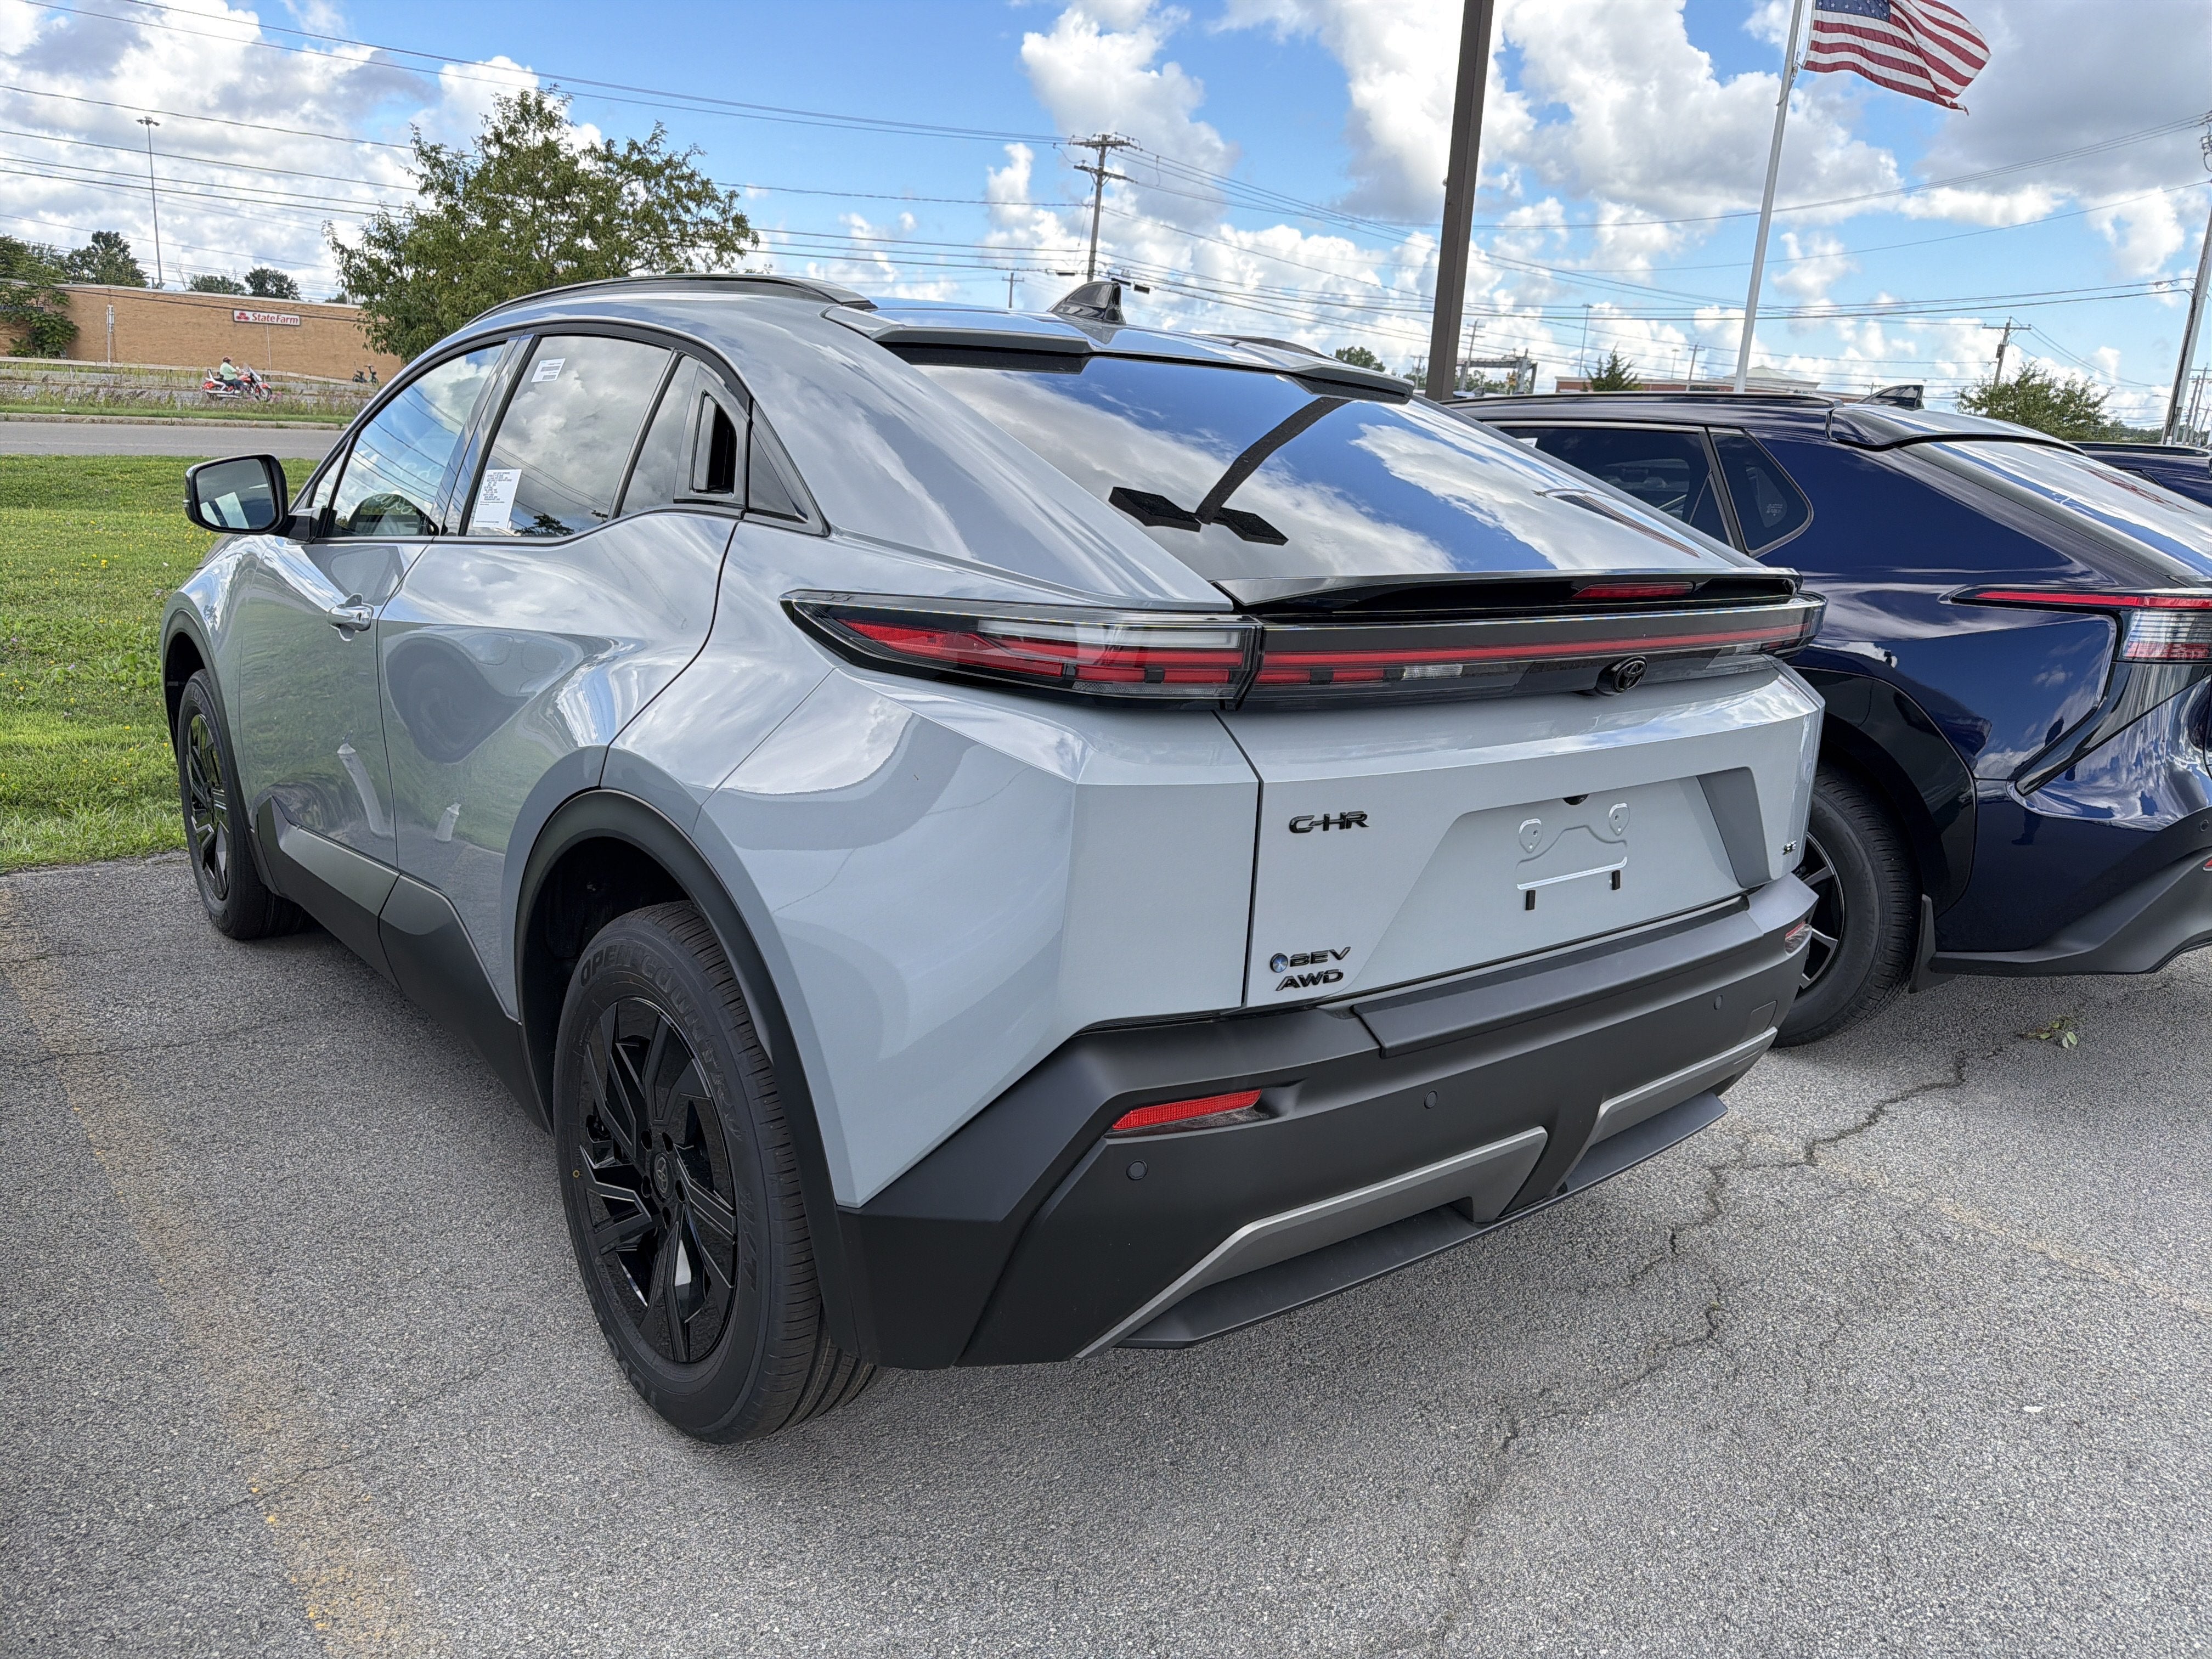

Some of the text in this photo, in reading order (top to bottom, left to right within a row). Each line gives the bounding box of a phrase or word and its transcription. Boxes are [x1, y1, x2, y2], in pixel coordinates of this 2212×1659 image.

[1289, 811, 1369, 833] C-HR
[1290, 946, 1351, 967] BEV
[1276, 969, 1344, 991] AWD
